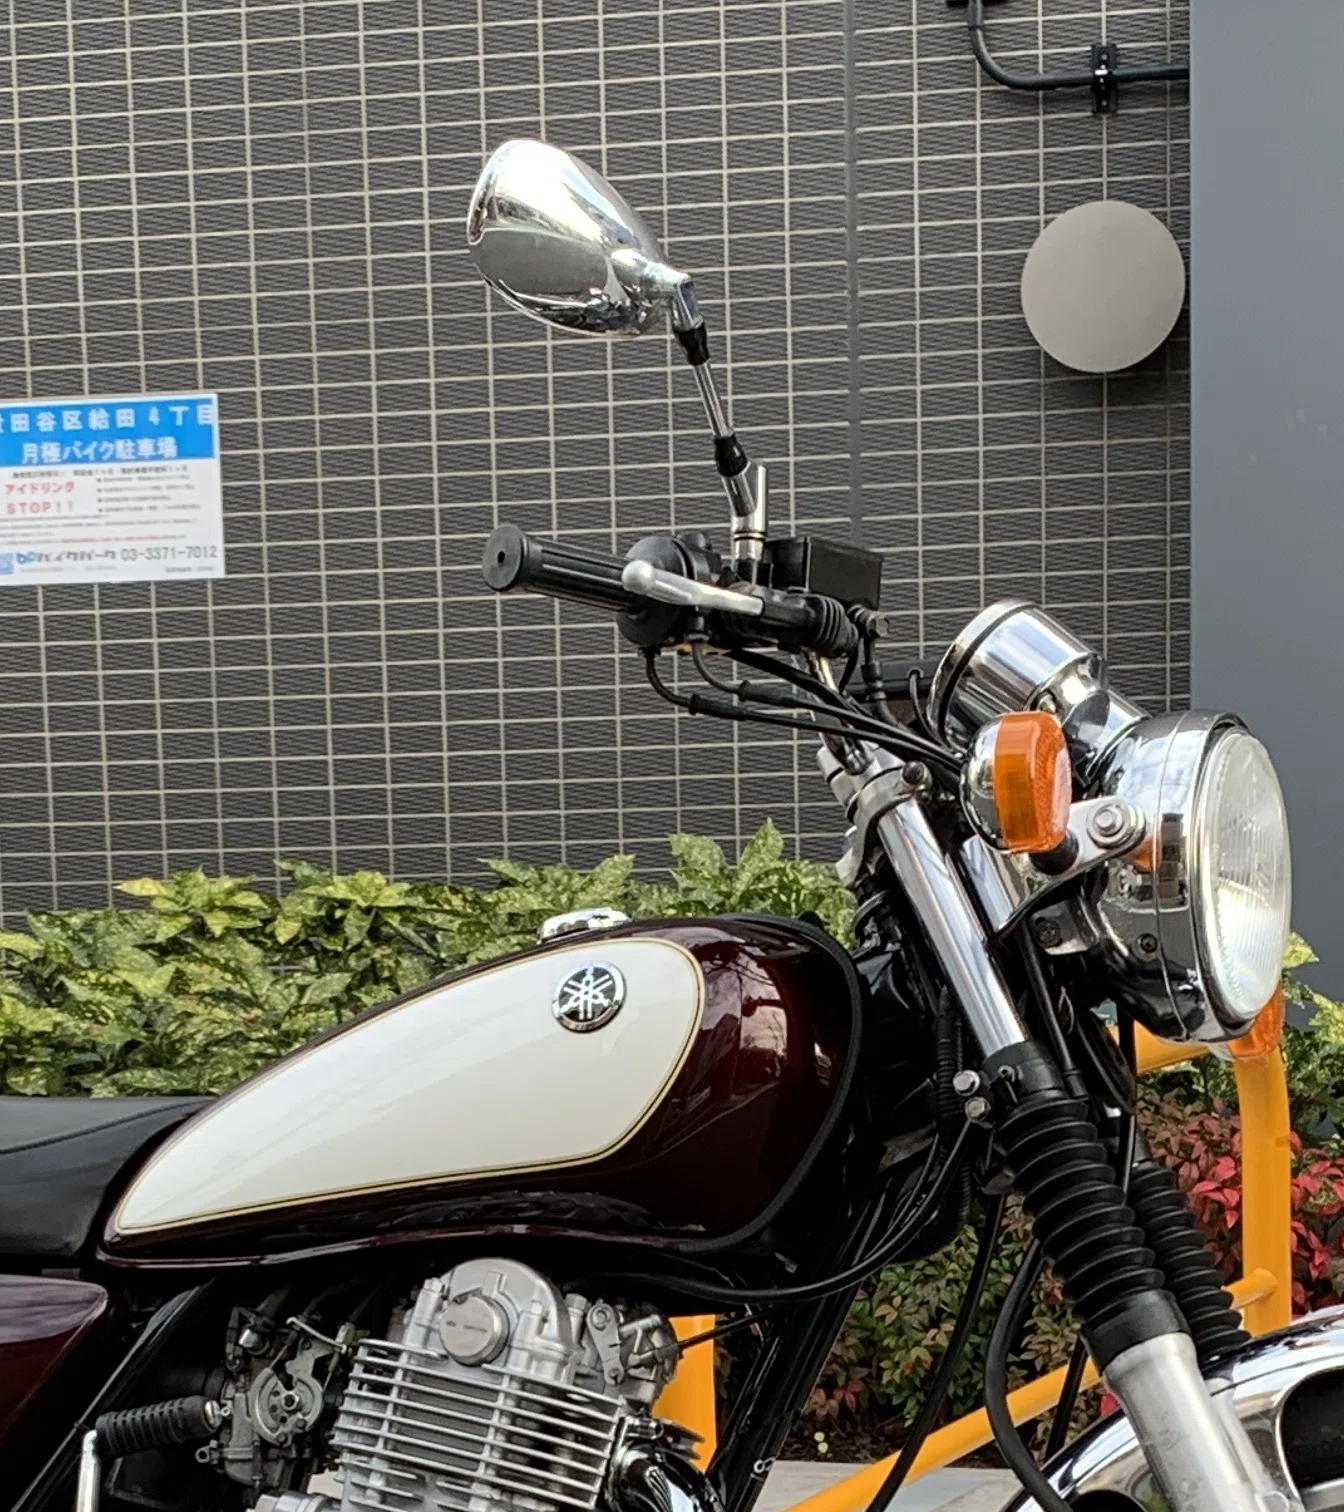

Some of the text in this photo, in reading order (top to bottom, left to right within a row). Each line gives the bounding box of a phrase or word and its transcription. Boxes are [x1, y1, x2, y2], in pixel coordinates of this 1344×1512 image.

[21, 435, 179, 464] 月極バイク駐車場
[121, 544, 218, 562] 03-3371-7012
